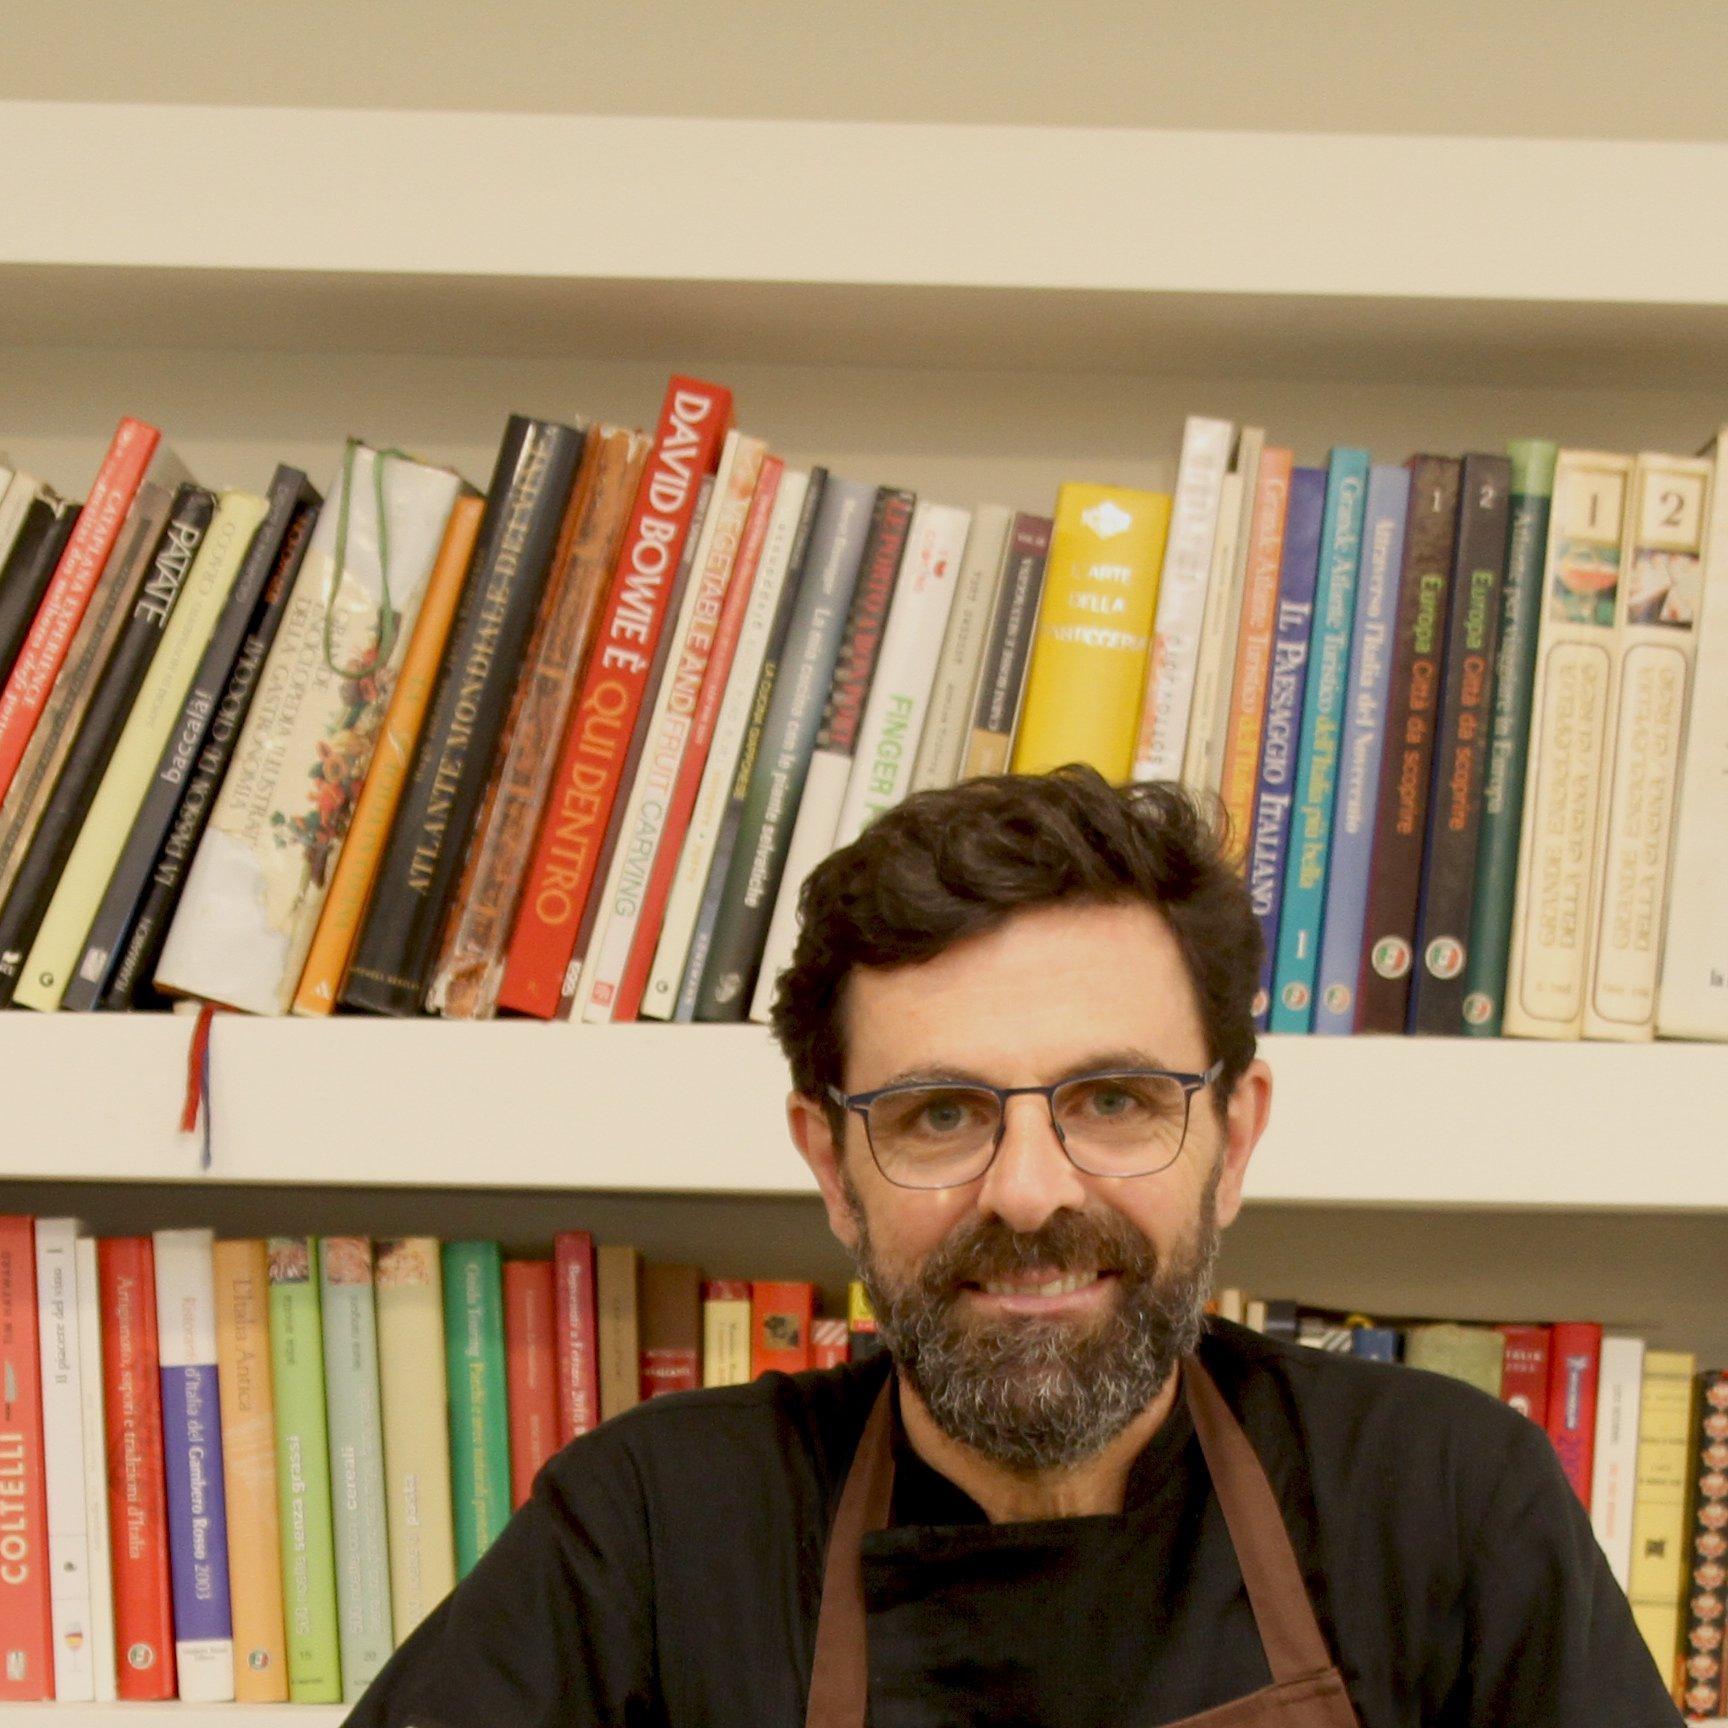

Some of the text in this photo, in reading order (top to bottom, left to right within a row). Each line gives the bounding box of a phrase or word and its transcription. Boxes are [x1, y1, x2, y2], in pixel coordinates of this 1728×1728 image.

[645, 389, 713, 516] DAVID
[1653, 492, 1678, 530] 2
[133, 522, 200, 631] PATATE
[607, 515, 682, 642] BOWIE
[575, 680, 627, 768] QUI
[600, 648, 649, 676] È
[613, 505, 748, 921] VEGETABLE AND FRUIT CARVING
[1315, 632, 1343, 714] Turistico
[1393, 574, 1442, 835] Europa Città da scoprire
[1445, 570, 1493, 831] Europa Città da scoprire
[160, 687, 213, 783] baccalà!
[407, 583, 515, 896] ATLANTE MONDIALE
[866, 695, 913, 796] FINGER
[1247, 600, 1311, 917] IL PAESAGGIO ITALIANO
[154, 864, 178, 887] LA
[533, 764, 601, 928] DENTRO
[743, 823, 781, 909] selvatiche
[231, 1278, 258, 1412] L'Italia Antica
[116, 1370, 145, 1560] sapori tradizioni d'Italia
[184, 1367, 211, 1600] d'Italia del Gambero Rosso 2003
[285, 1434, 308, 1552] senza grassi
